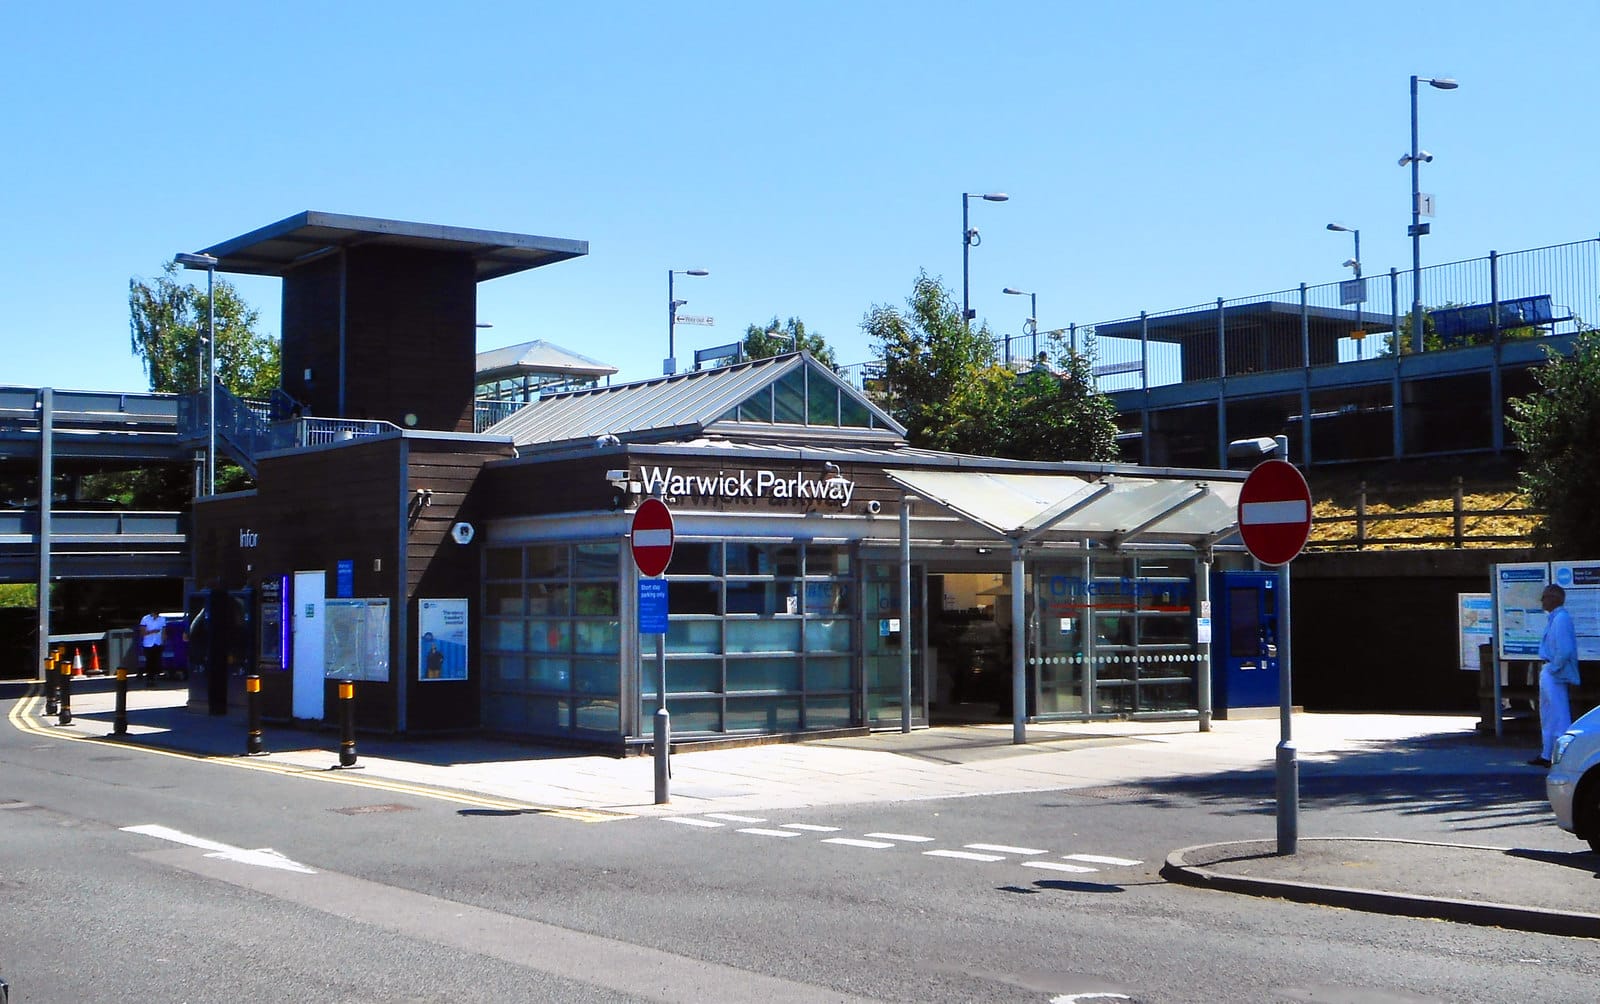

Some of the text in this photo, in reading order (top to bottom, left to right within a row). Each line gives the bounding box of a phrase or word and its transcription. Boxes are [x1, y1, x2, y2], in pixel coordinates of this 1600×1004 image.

[1424, 197, 1431, 214] 1
[640, 466, 854, 507] Warwick Parkway
